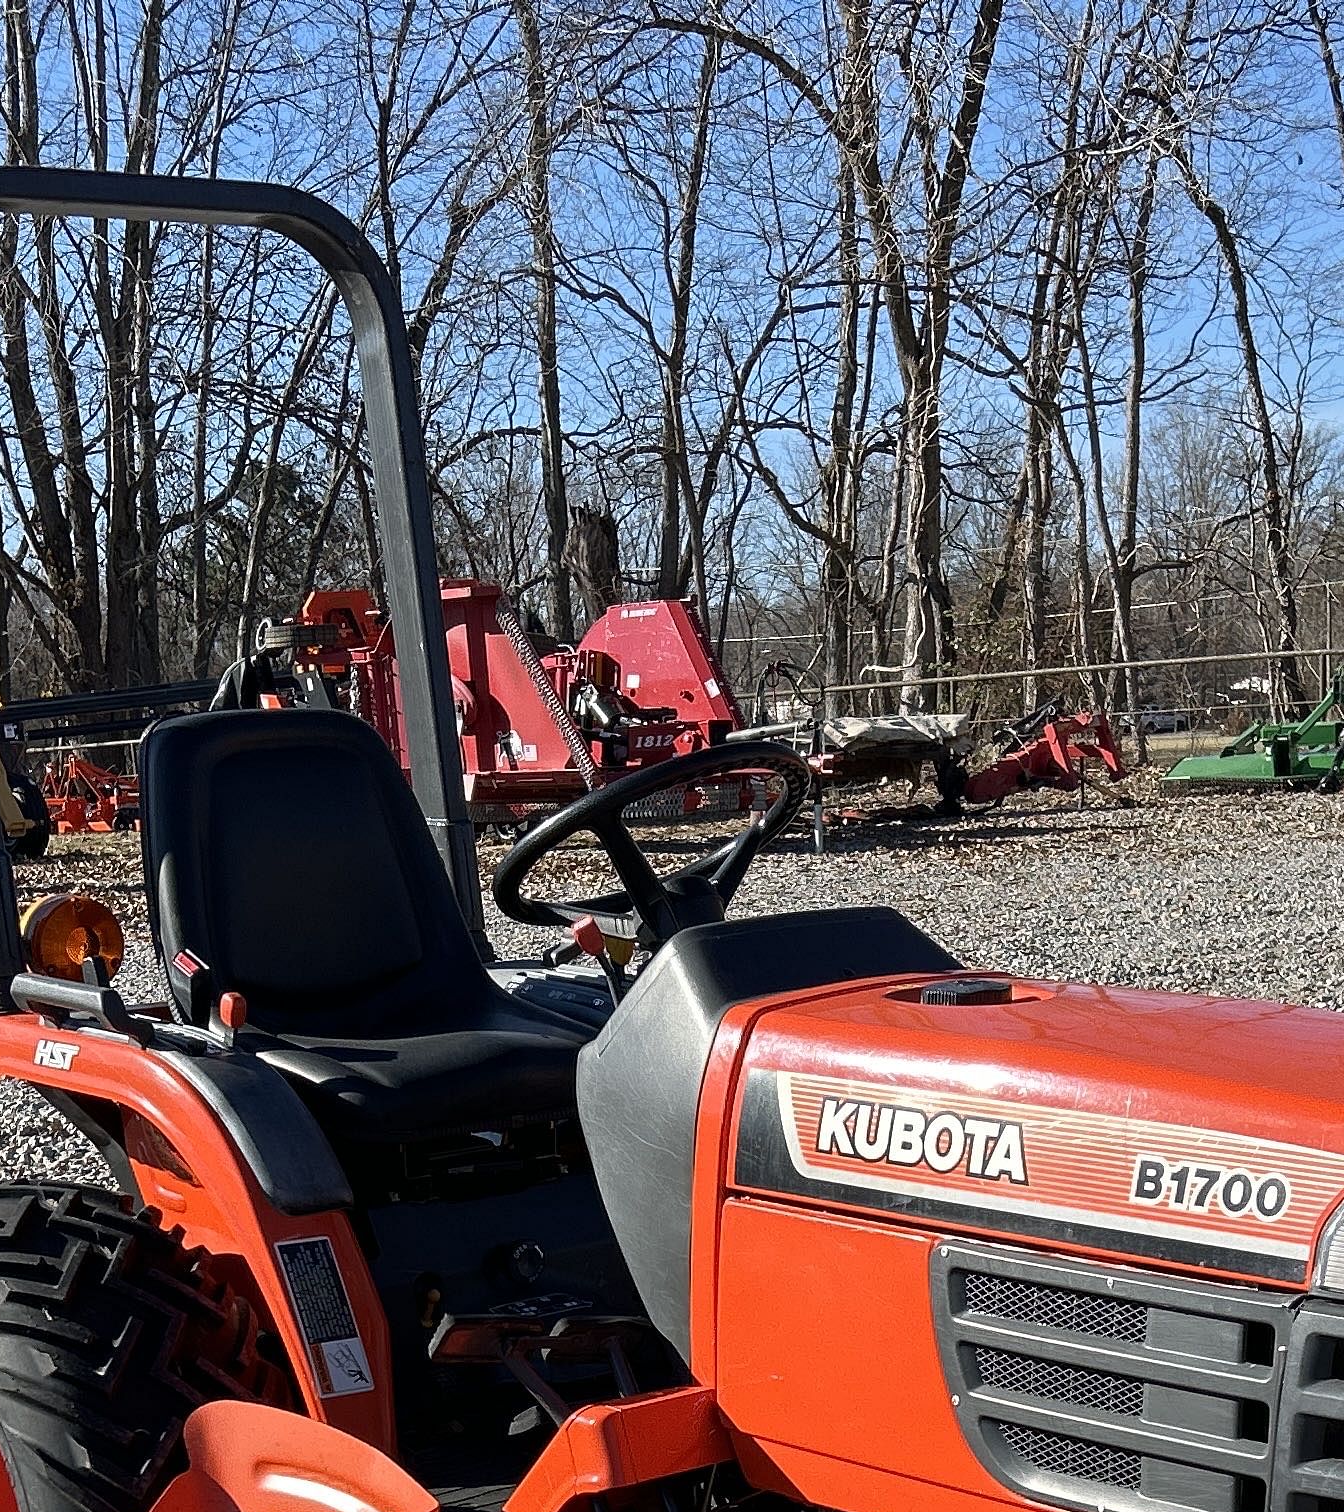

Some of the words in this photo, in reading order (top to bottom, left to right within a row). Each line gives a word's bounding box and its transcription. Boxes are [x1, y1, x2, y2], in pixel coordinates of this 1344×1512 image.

[635, 733, 674, 749] 1812
[33, 1038, 81, 1071] HST
[815, 1095, 1031, 1187] KUBOTA
[1128, 1153, 1293, 1223] B1700
